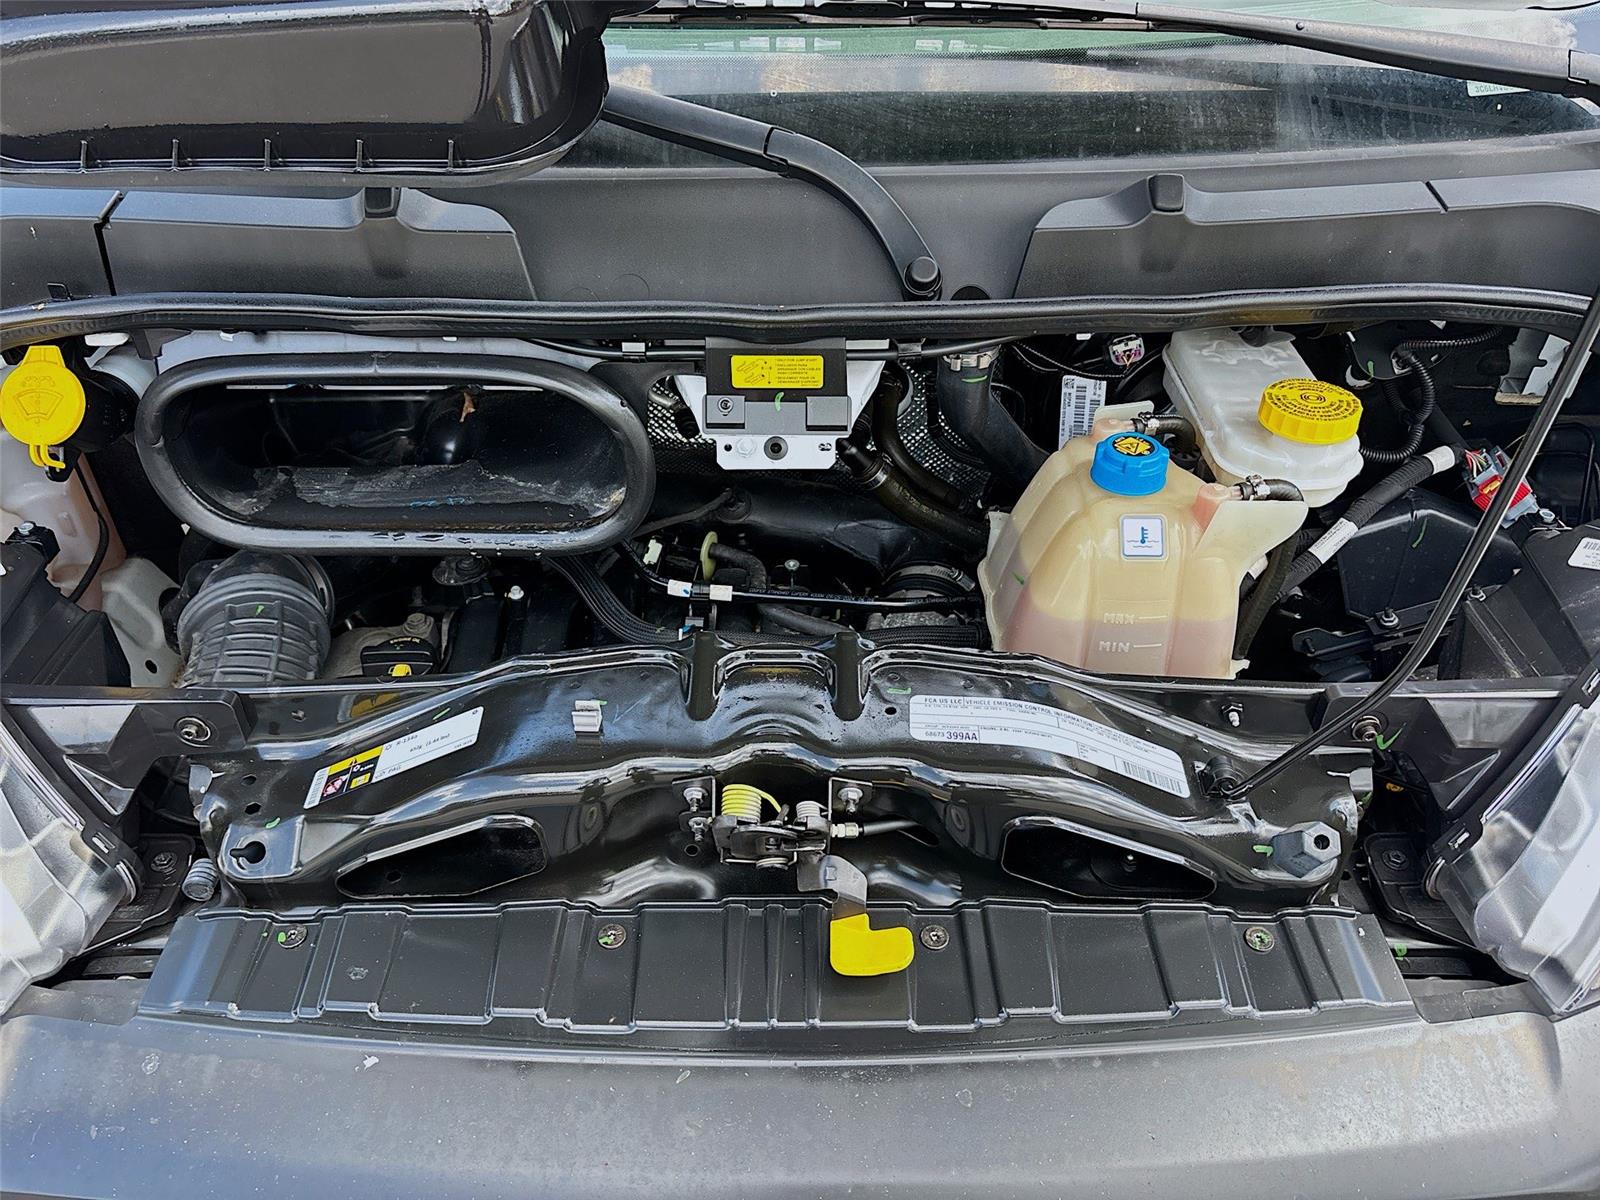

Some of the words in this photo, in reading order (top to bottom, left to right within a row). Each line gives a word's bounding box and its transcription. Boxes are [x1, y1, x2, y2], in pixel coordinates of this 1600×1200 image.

[1103, 612, 1136, 625] MAX
[1098, 640, 1130, 652] MIN
[993, 700, 1023, 708] EMISSION
[1024, 704, 1052, 714] CONTROL
[1053, 711, 1094, 728] INFORMATION
[946, 731, 978, 740] 399AA
